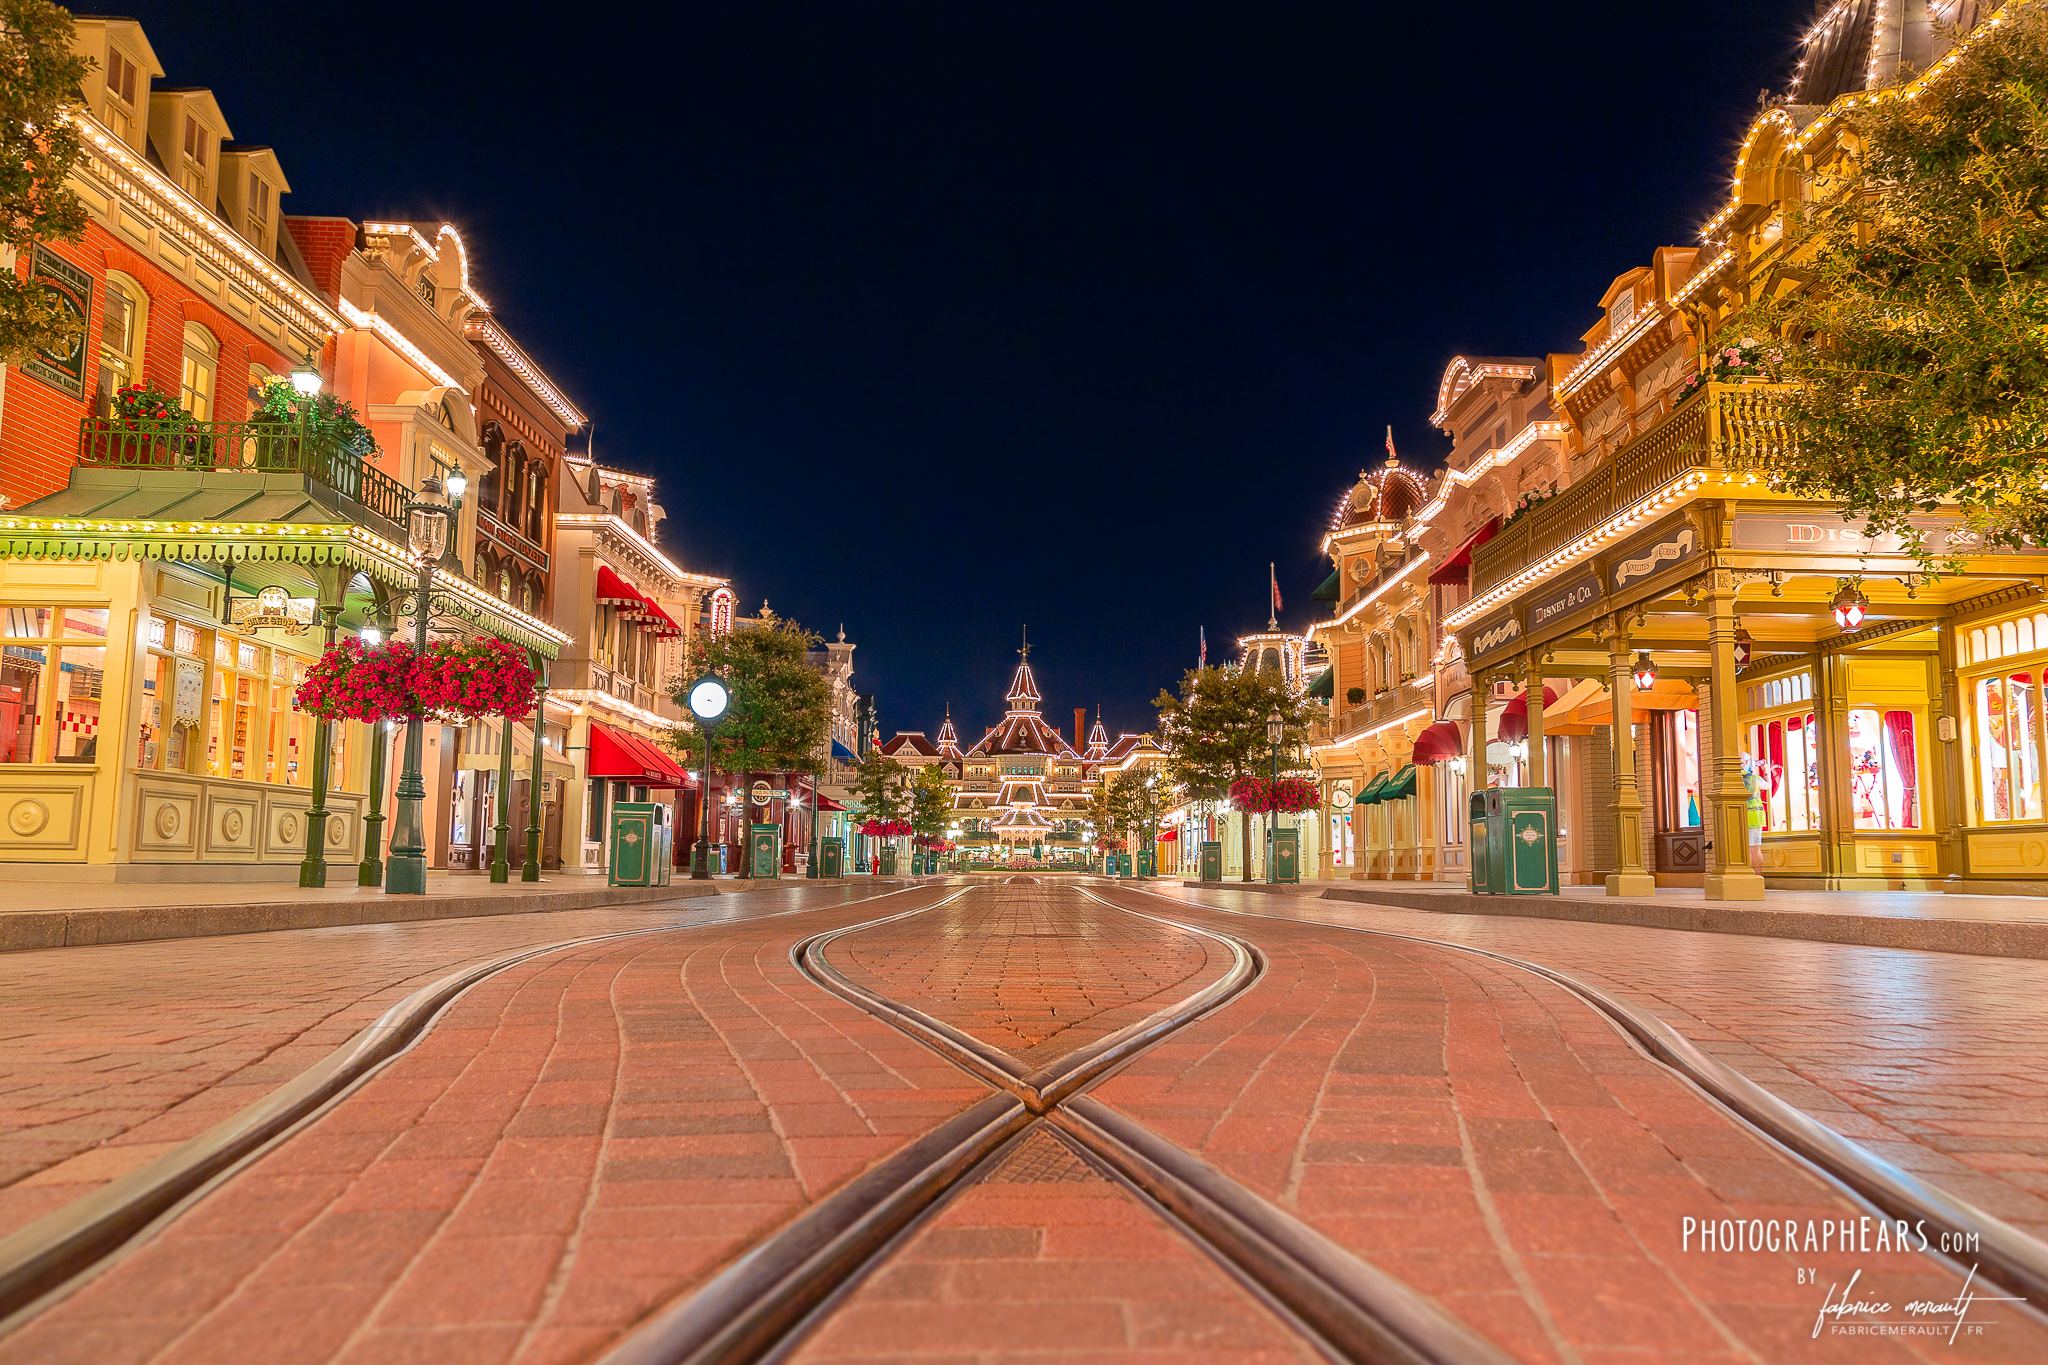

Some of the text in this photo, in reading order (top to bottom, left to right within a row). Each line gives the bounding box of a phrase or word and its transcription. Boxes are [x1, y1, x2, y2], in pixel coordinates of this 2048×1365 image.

[477, 514, 546, 568] MAIN STREET GAZETTE
[1945, 530, 1979, 544] &
[1625, 560, 1650, 574] NOVELTIES
[1659, 545, 1677, 558] CURIOS
[246, 616, 293, 629] BAKE SHOP
[1535, 599, 1566, 624] DISNEY
[1567, 593, 1576, 607] &
